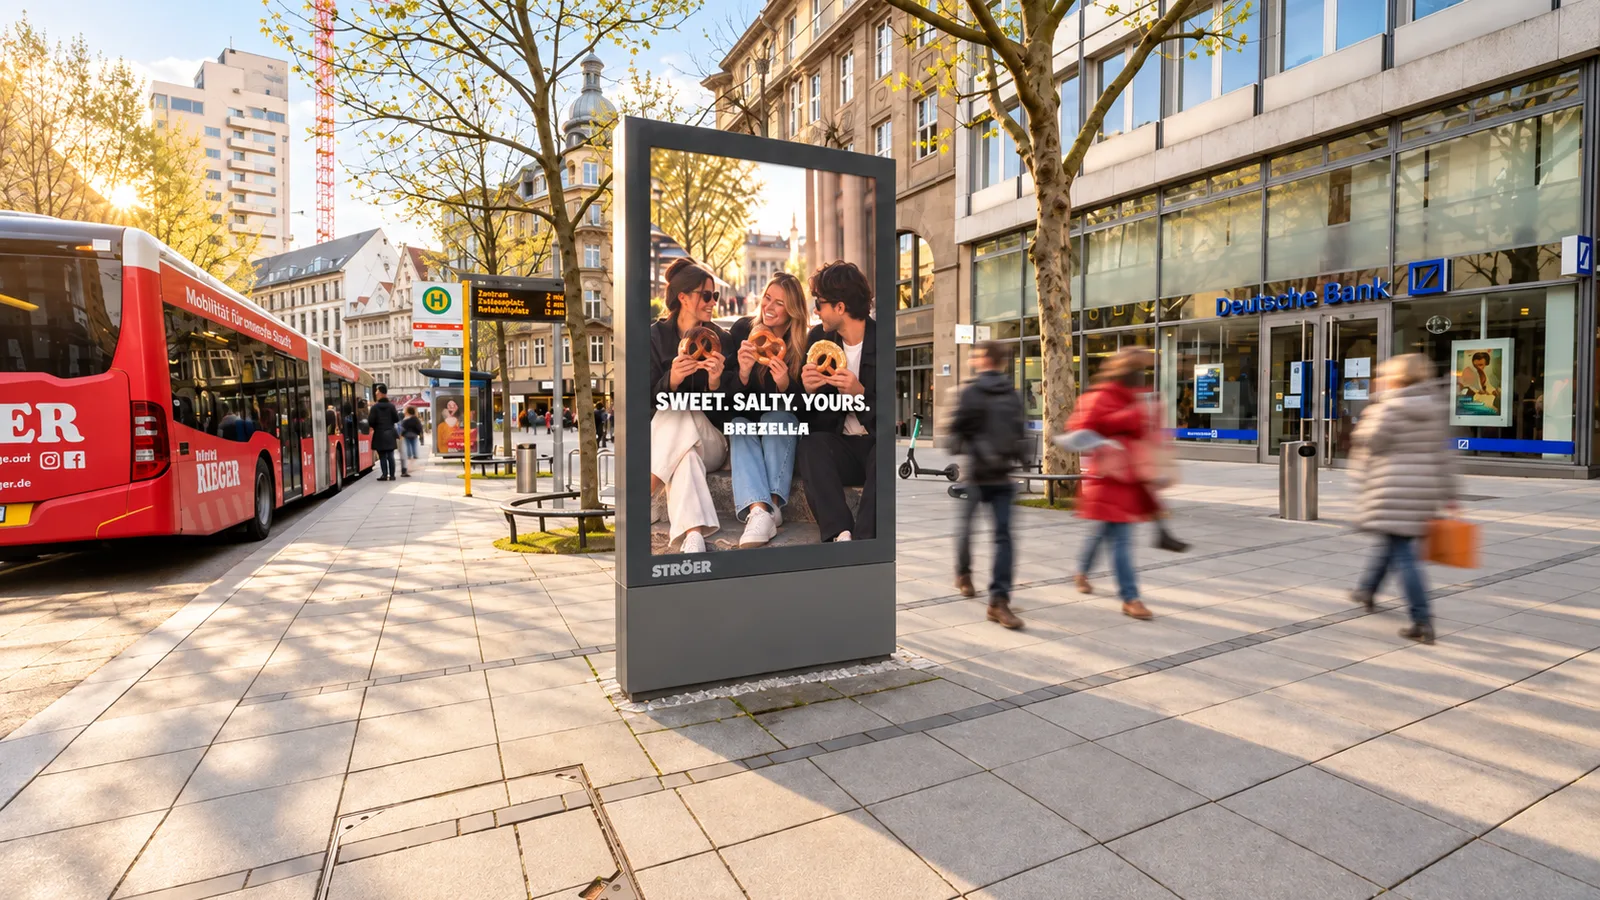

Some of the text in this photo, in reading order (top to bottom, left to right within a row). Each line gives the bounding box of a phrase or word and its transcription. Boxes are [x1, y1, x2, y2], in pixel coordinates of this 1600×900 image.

[186, 286, 230, 322] Mobilität
[431, 293, 443, 307] H
[1216, 276, 1391, 316] Deutsche Bank
[656, 392, 871, 412] SWEET. SALTY. YOURS.
[723, 422, 809, 435] BREZELLA
[196, 460, 241, 494] RIEGER
[651, 559, 712, 577] STRÖER
